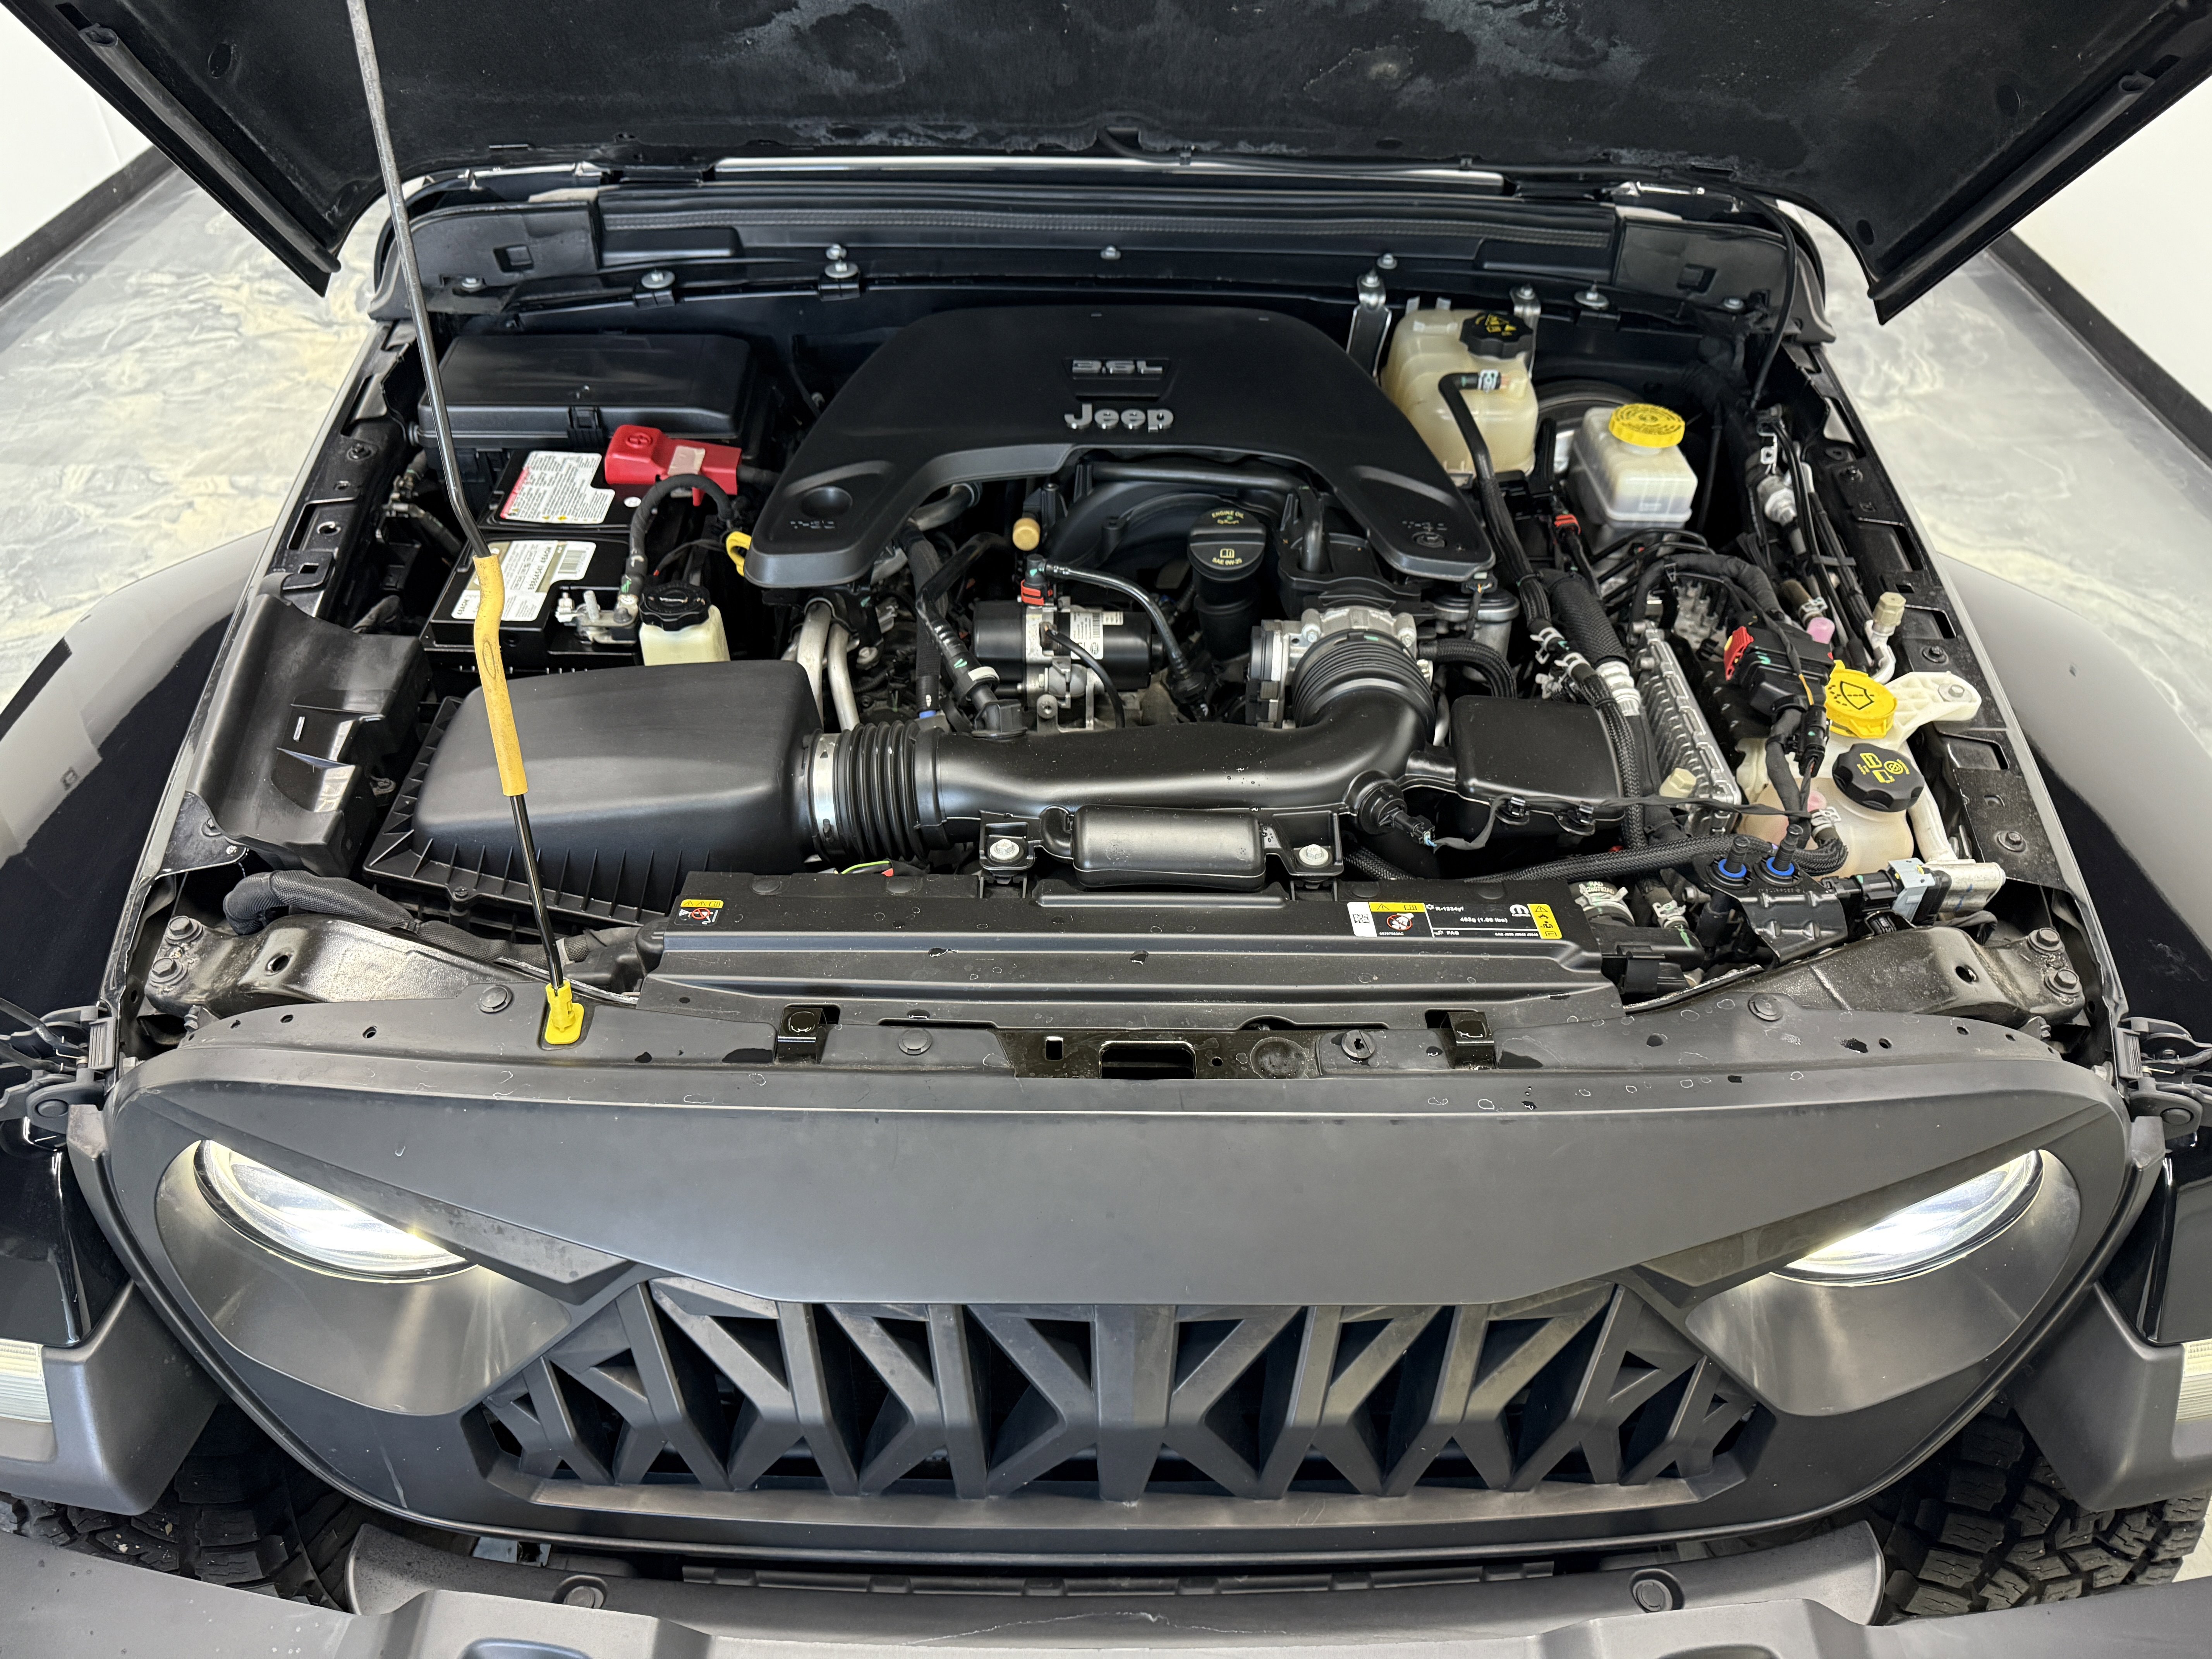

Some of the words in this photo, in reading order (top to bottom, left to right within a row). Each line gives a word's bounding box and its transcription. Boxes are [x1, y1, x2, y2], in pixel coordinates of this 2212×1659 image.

[1064, 402, 1174, 433] Jeep
[1211, 510, 1234, 519] ENGINE
[1235, 511, 1244, 519] OIL
[1212, 557, 1224, 565] SAE
